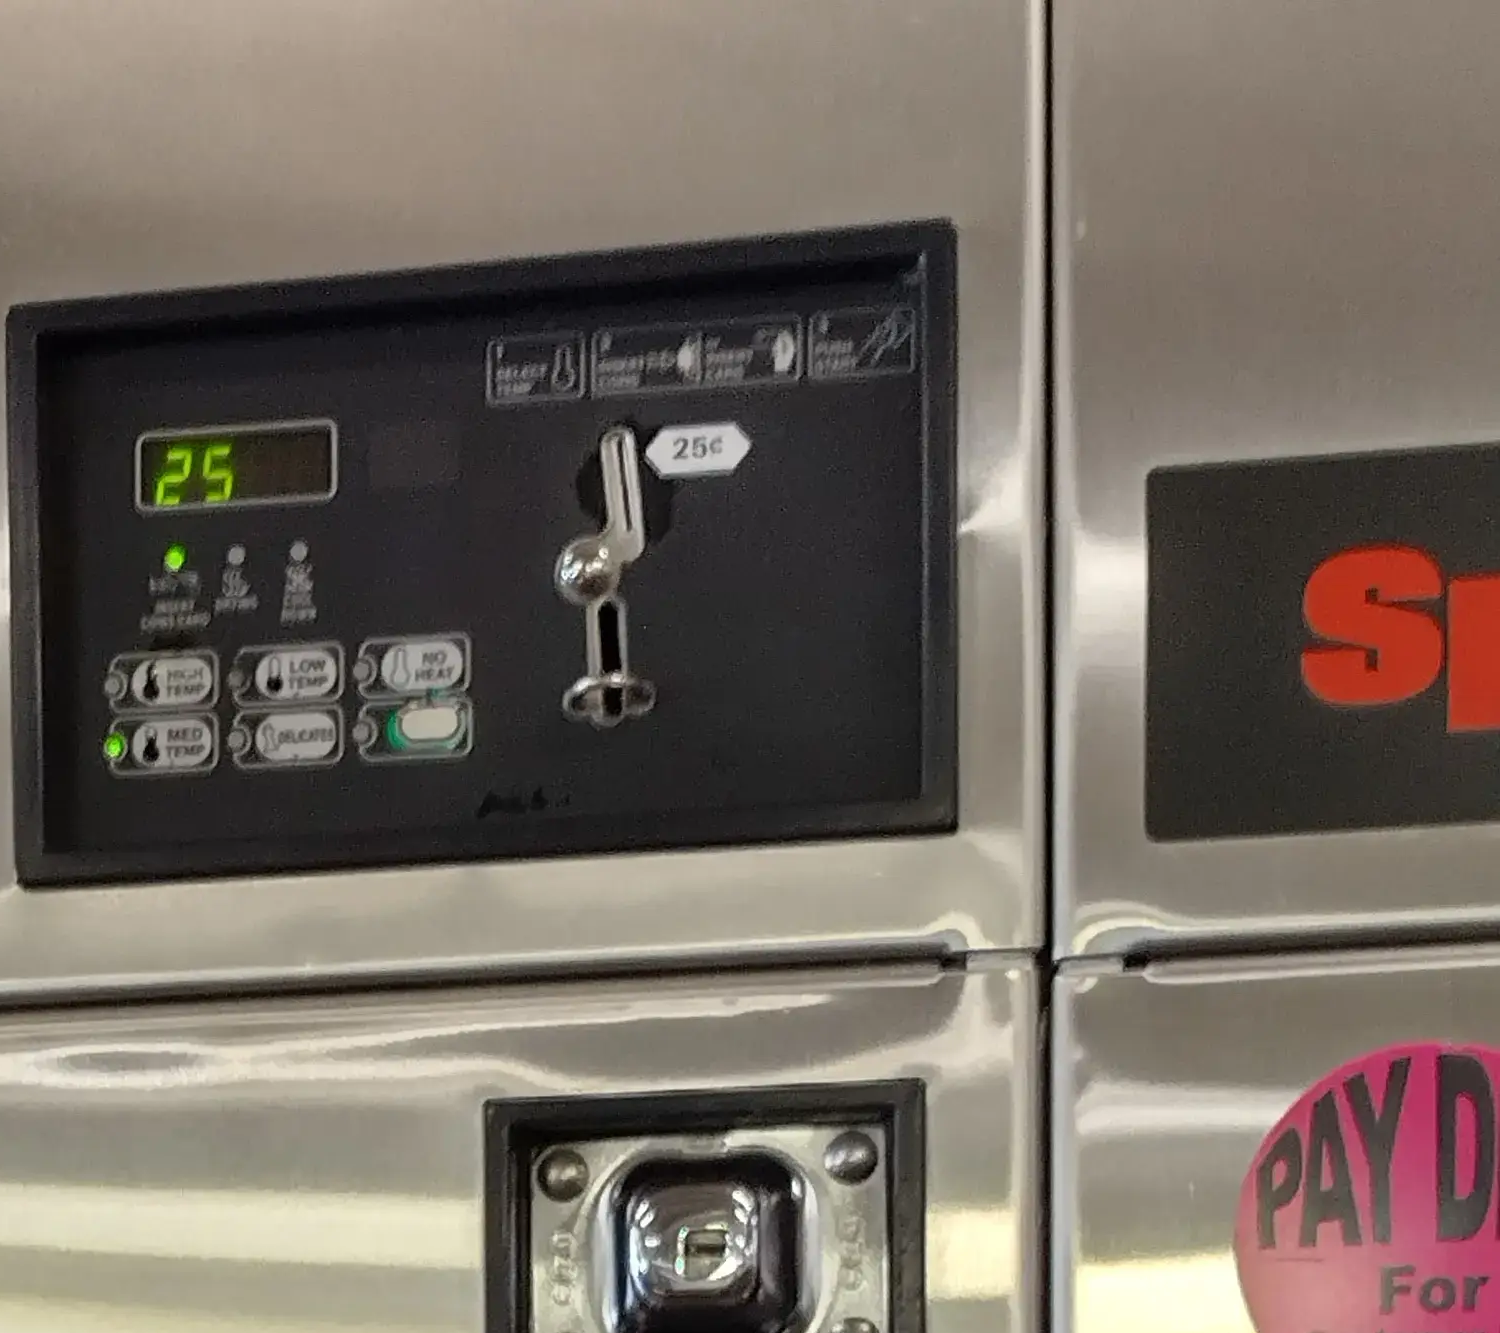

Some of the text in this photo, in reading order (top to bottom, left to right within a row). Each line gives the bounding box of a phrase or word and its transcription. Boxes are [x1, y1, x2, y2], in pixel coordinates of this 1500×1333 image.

[672, 434, 724, 460] 25¢
[156, 444, 233, 506] 25
[421, 649, 448, 666] NO
[289, 659, 328, 674] LOW
[414, 666, 455, 682] HEAT
[166, 727, 204, 743] MED
[165, 744, 206, 759] TEMP
[1256, 1054, 1500, 1250] PAY D
[1379, 1264, 1490, 1316] For
